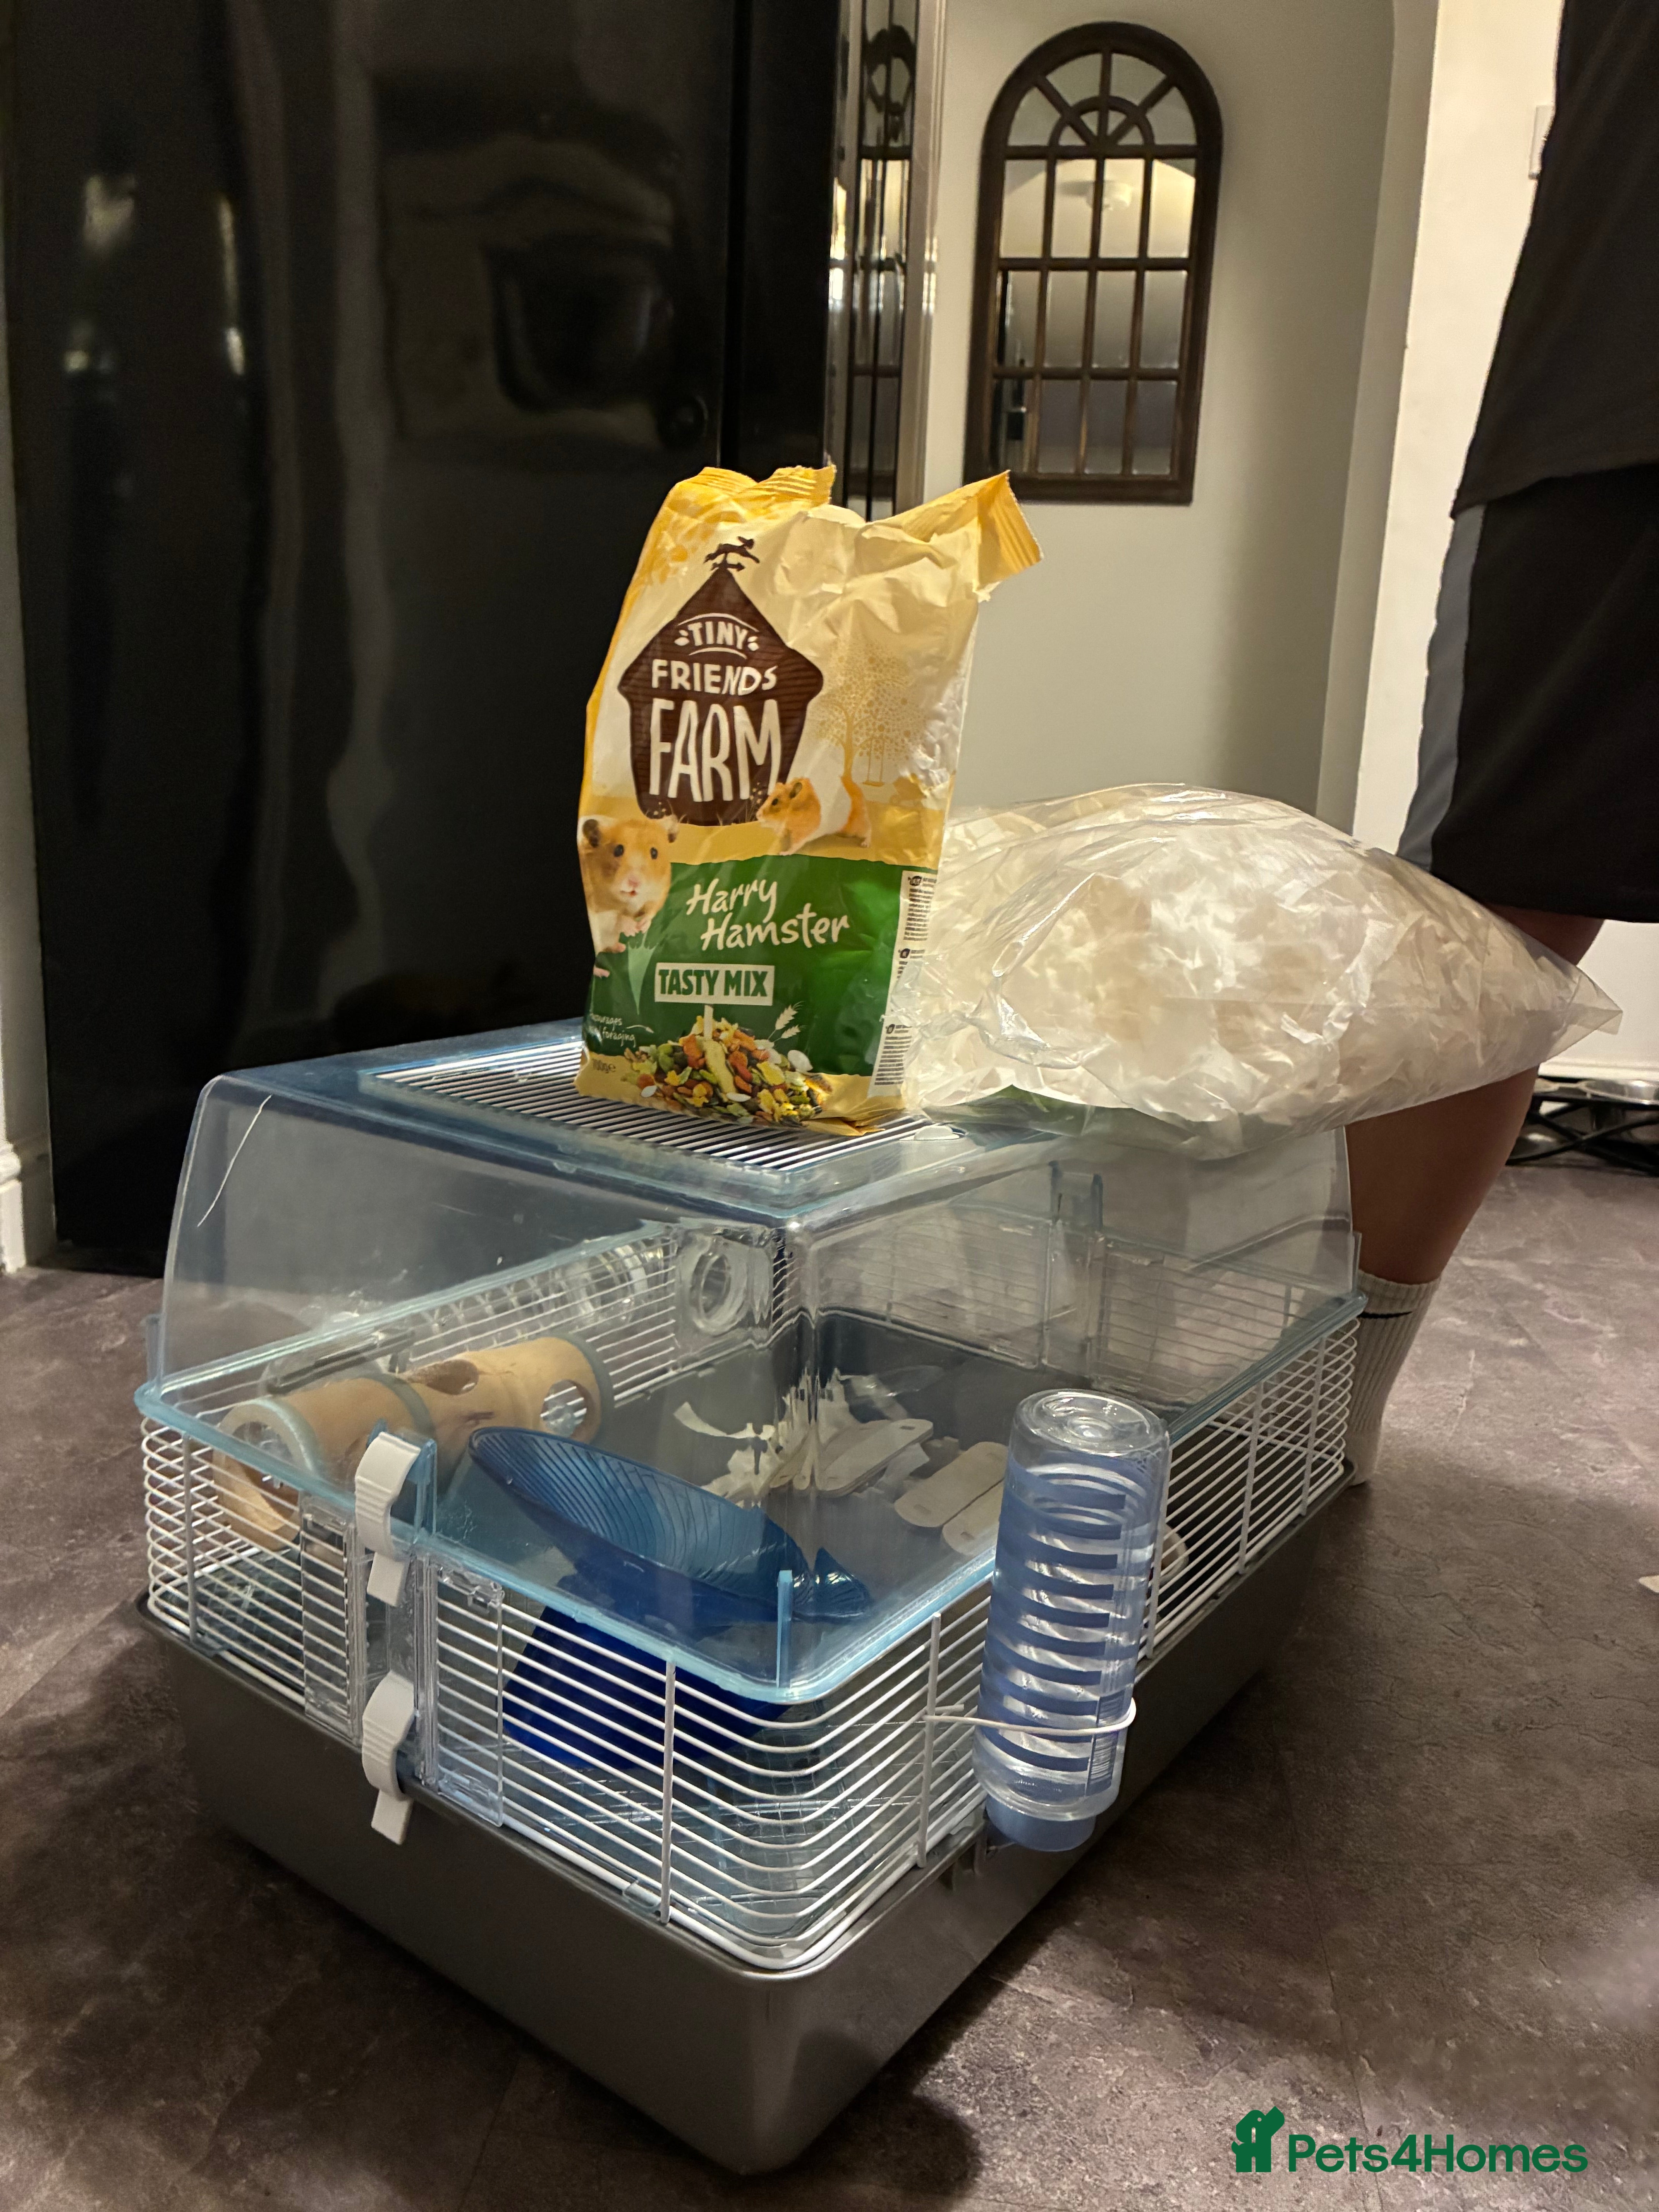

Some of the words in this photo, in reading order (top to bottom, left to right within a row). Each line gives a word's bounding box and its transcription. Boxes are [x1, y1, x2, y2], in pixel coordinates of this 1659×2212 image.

[688, 621, 748, 649] TINY
[651, 659, 778, 696] FRIENDS
[649, 698, 781, 802] FARM
[686, 878, 777, 923] Harry
[701, 903, 850, 951] Hamster
[659, 969, 720, 996] TASTY
[724, 970, 768, 997] MIX
